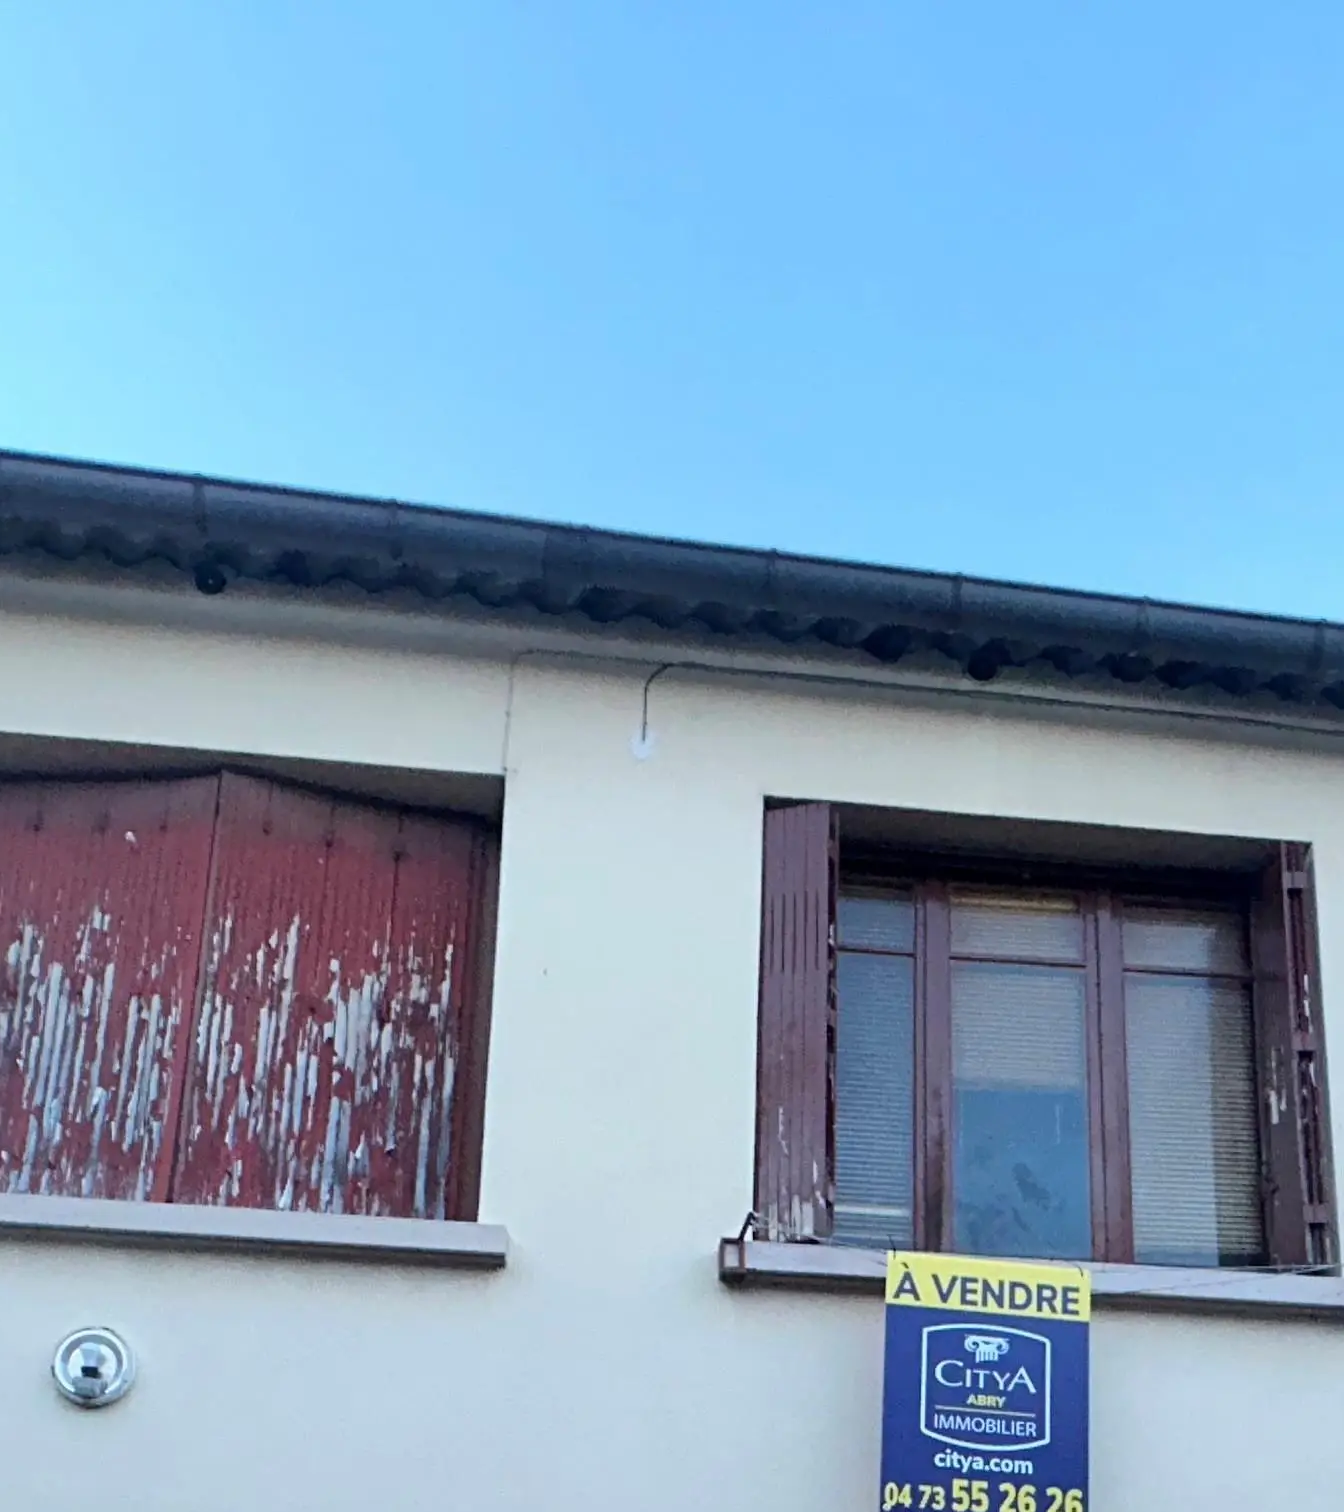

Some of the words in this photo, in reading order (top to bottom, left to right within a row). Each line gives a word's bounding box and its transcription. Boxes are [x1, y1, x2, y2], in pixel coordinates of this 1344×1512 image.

[893, 1262, 921, 1301] À
[931, 1273, 1080, 1315] VENDRE
[966, 1394, 1006, 1408] ABRY
[934, 1414, 1037, 1437] IMMOBILIER
[934, 1449, 1033, 1474] citya.com
[884, 1482, 912, 1508] 04
[918, 1484, 945, 1510] 73
